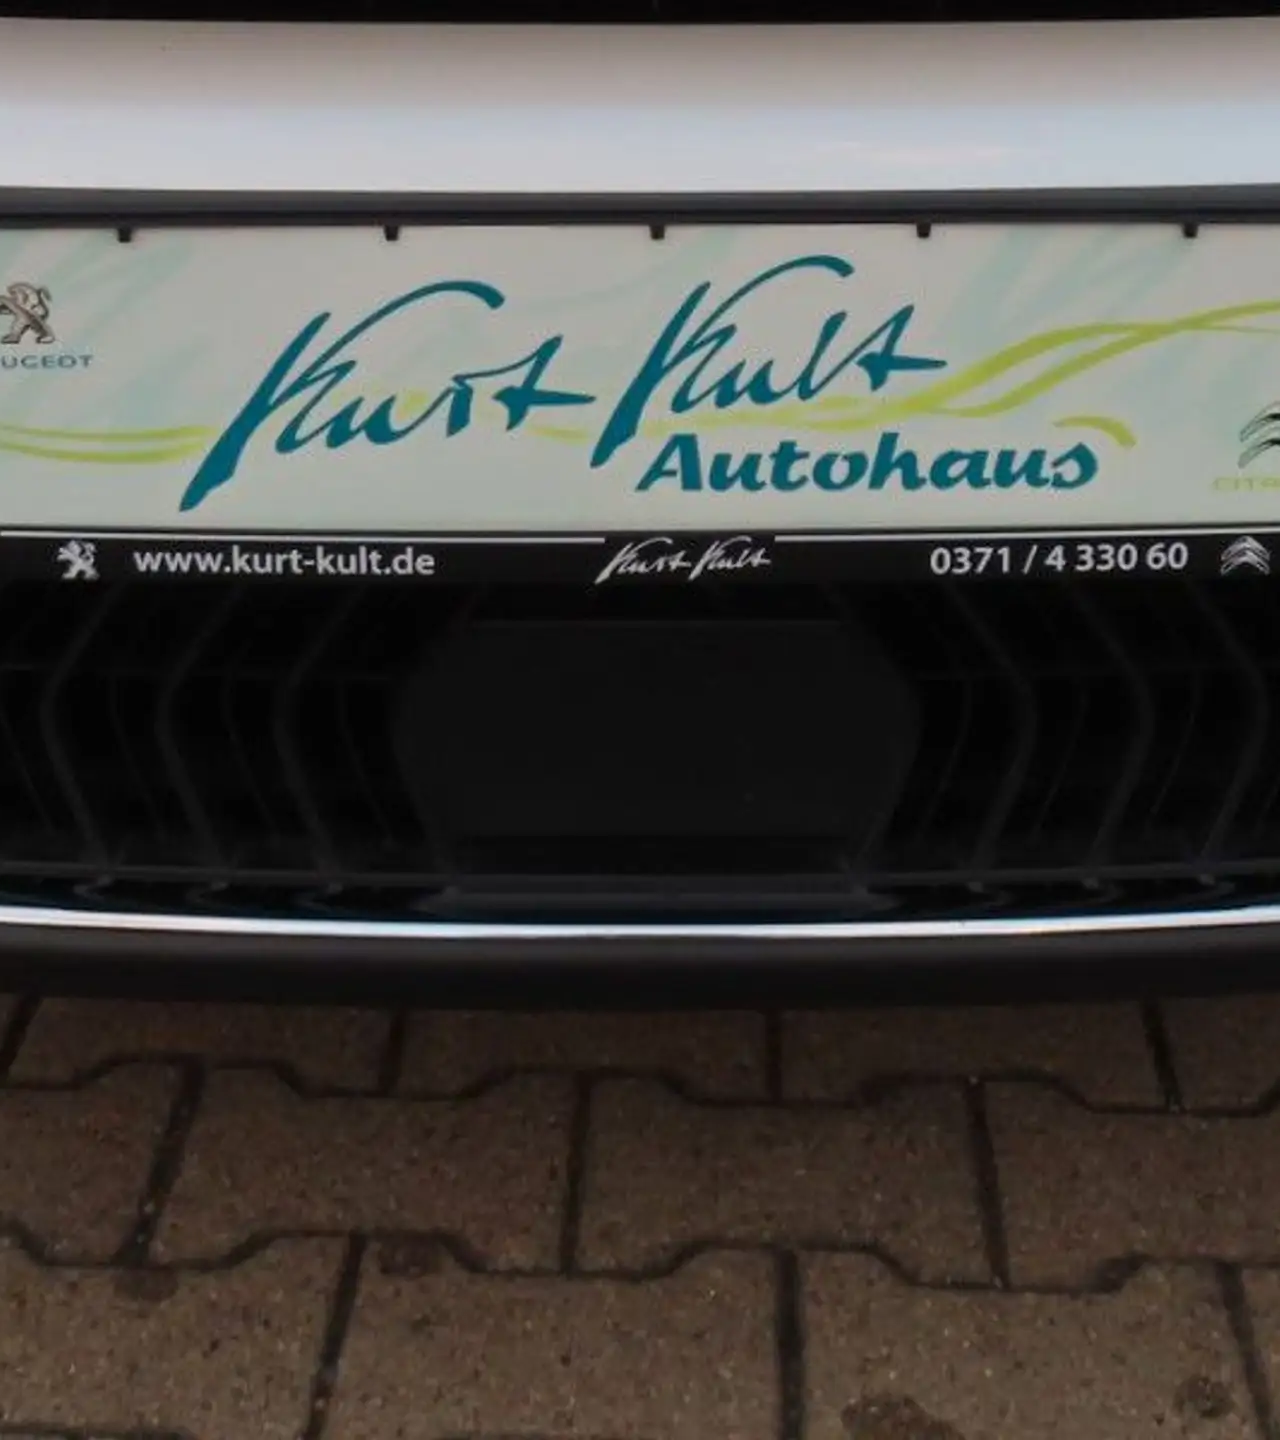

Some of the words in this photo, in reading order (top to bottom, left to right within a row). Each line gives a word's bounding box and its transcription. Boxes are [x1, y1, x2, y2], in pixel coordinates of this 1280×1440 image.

[179, 280, 596, 512] Kurt
[590, 255, 948, 468] Kult
[635, 432, 1098, 492] Autohaus
[133, 545, 436, 576] www.kurt-kult.de
[594, 536, 692, 585] Kurt
[688, 535, 771, 581] Kult
[930, 545, 1012, 575] 0371
[1044, 545, 1067, 572] 4
[1075, 543, 1138, 571] 330
[1145, 542, 1189, 569] 60
